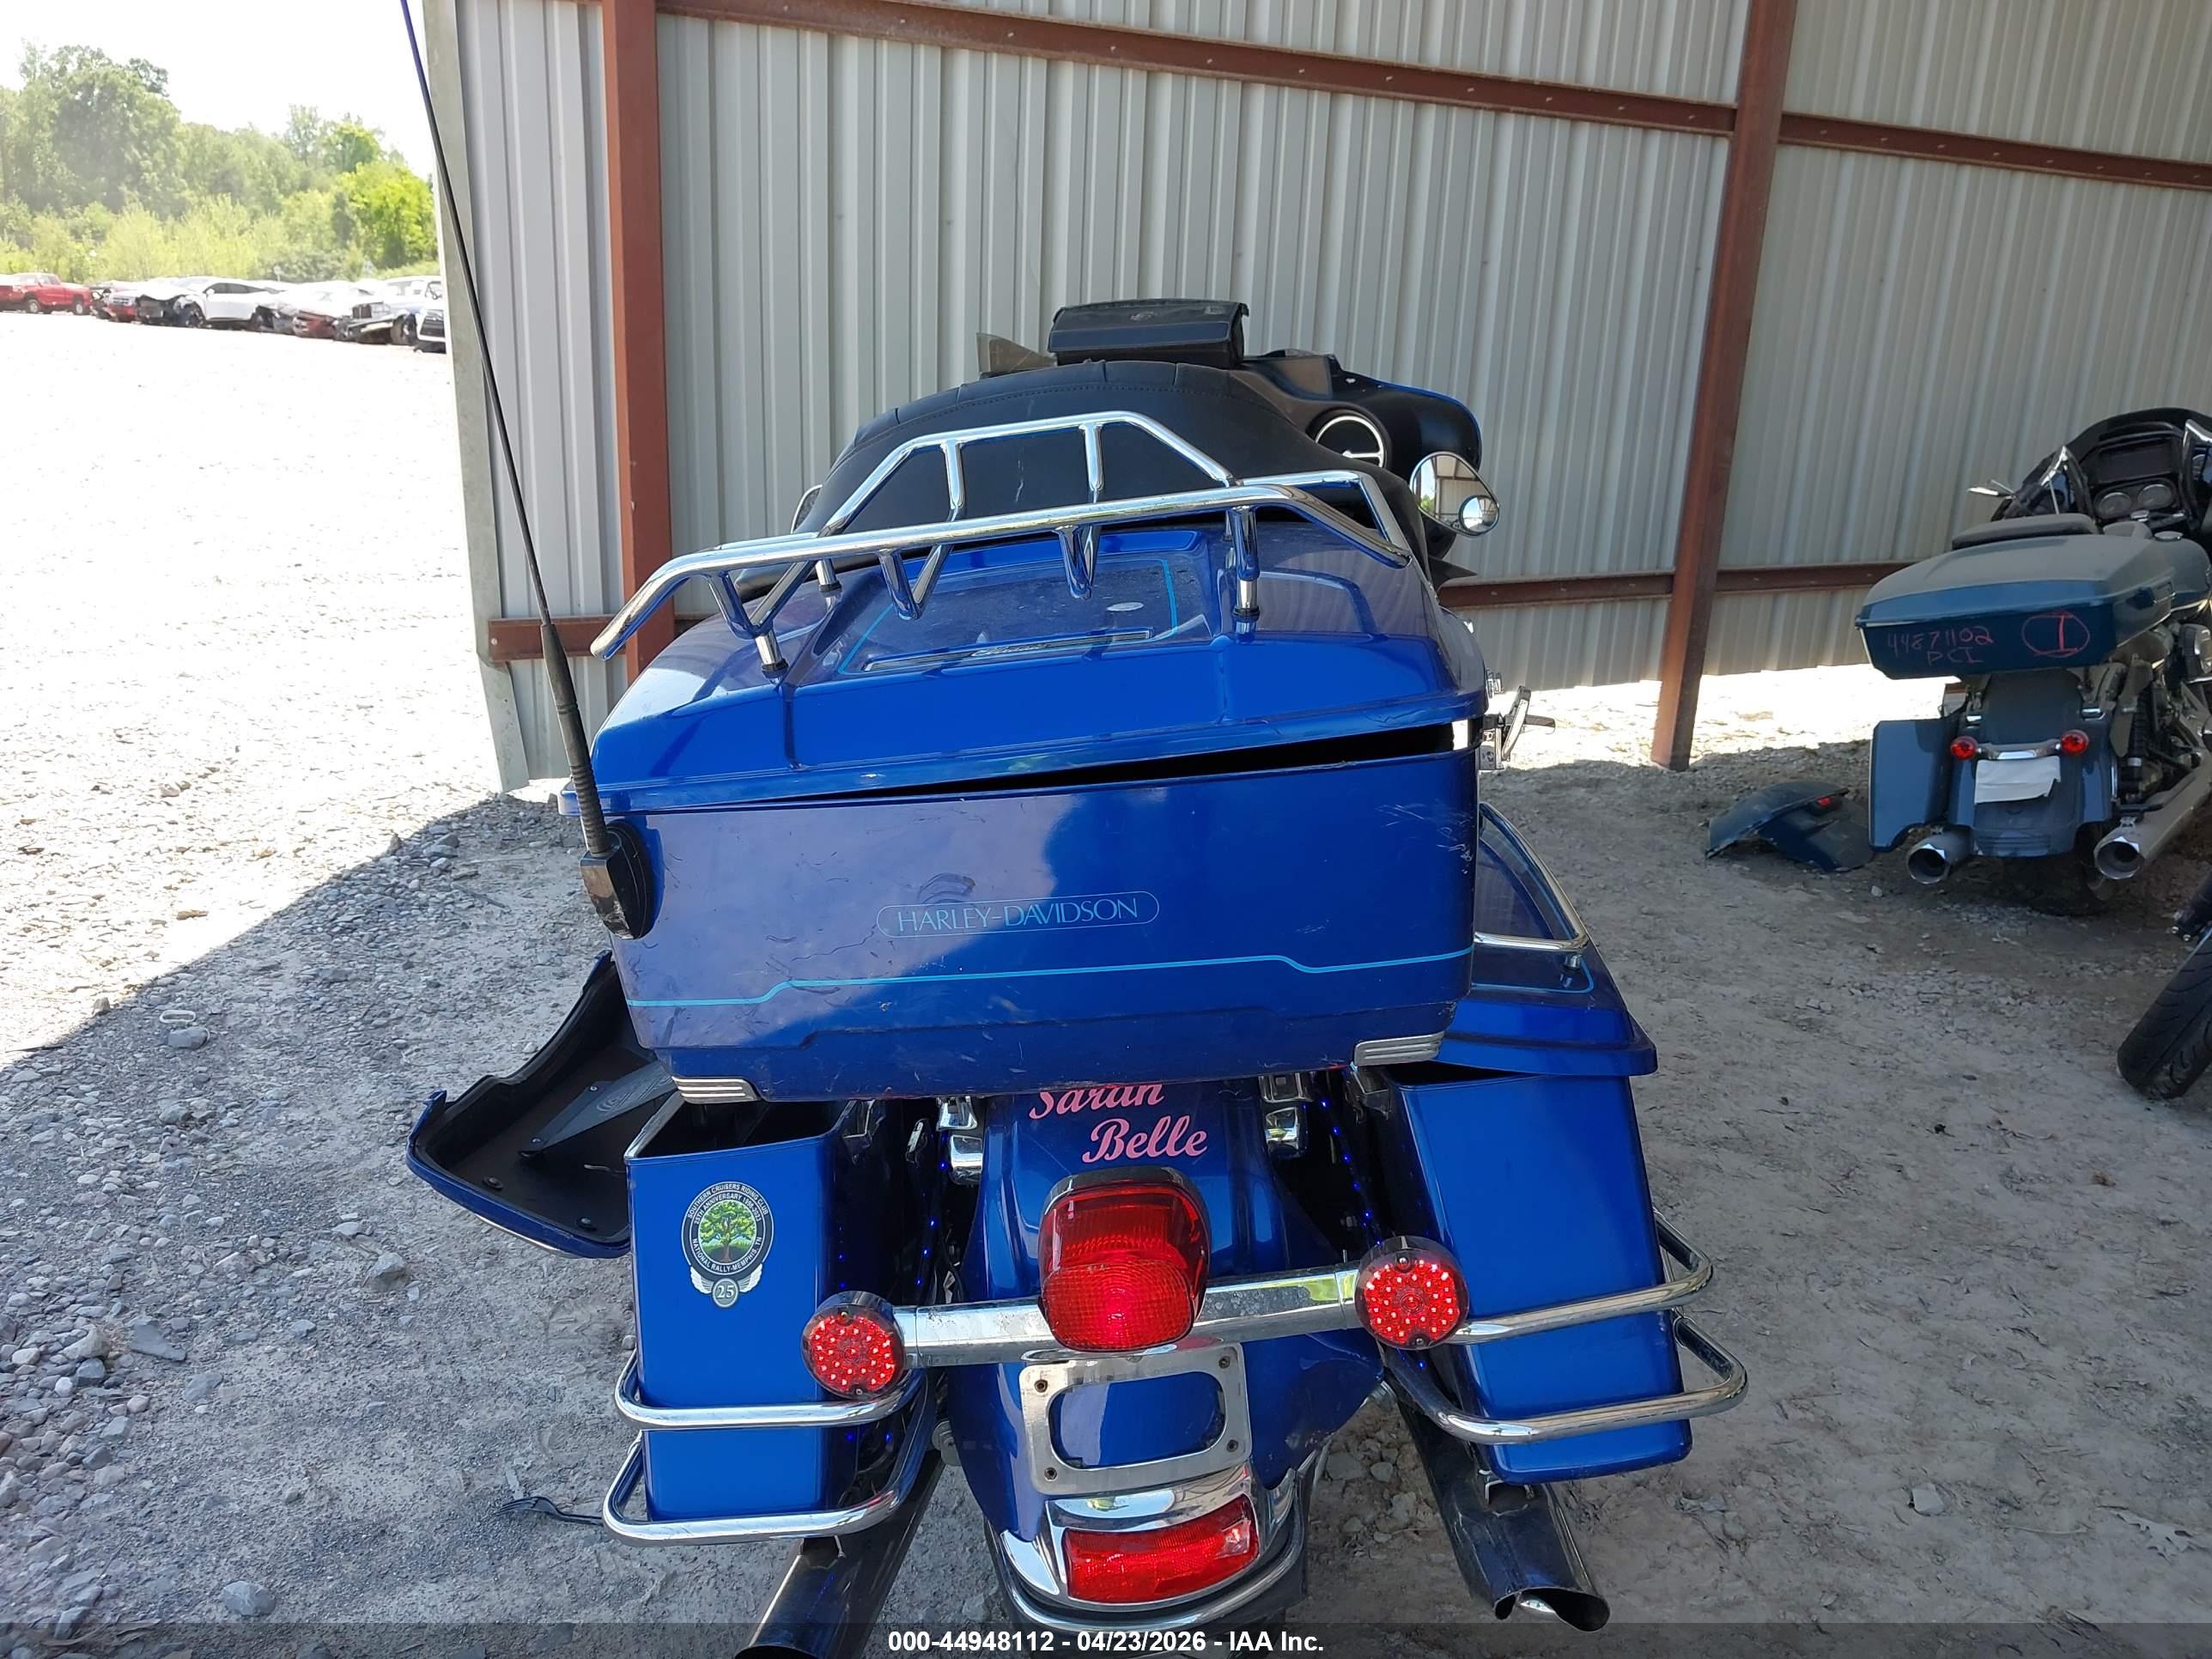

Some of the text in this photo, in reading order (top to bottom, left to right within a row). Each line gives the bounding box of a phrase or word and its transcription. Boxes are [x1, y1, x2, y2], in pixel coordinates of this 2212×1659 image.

[897, 897, 1139, 932] HARLEY-DAVIDSON
[1082, 1115, 1208, 1164] Belle
[688, 1184, 769, 1218] SOUTHERN CRUISERS RIDING CLUB
[694, 1209, 706, 1224] 25TH
[702, 1193, 743, 1212] ANNIVERSARY
[691, 1237, 712, 1267] NATIONAL
[717, 1285, 735, 1298] 25
